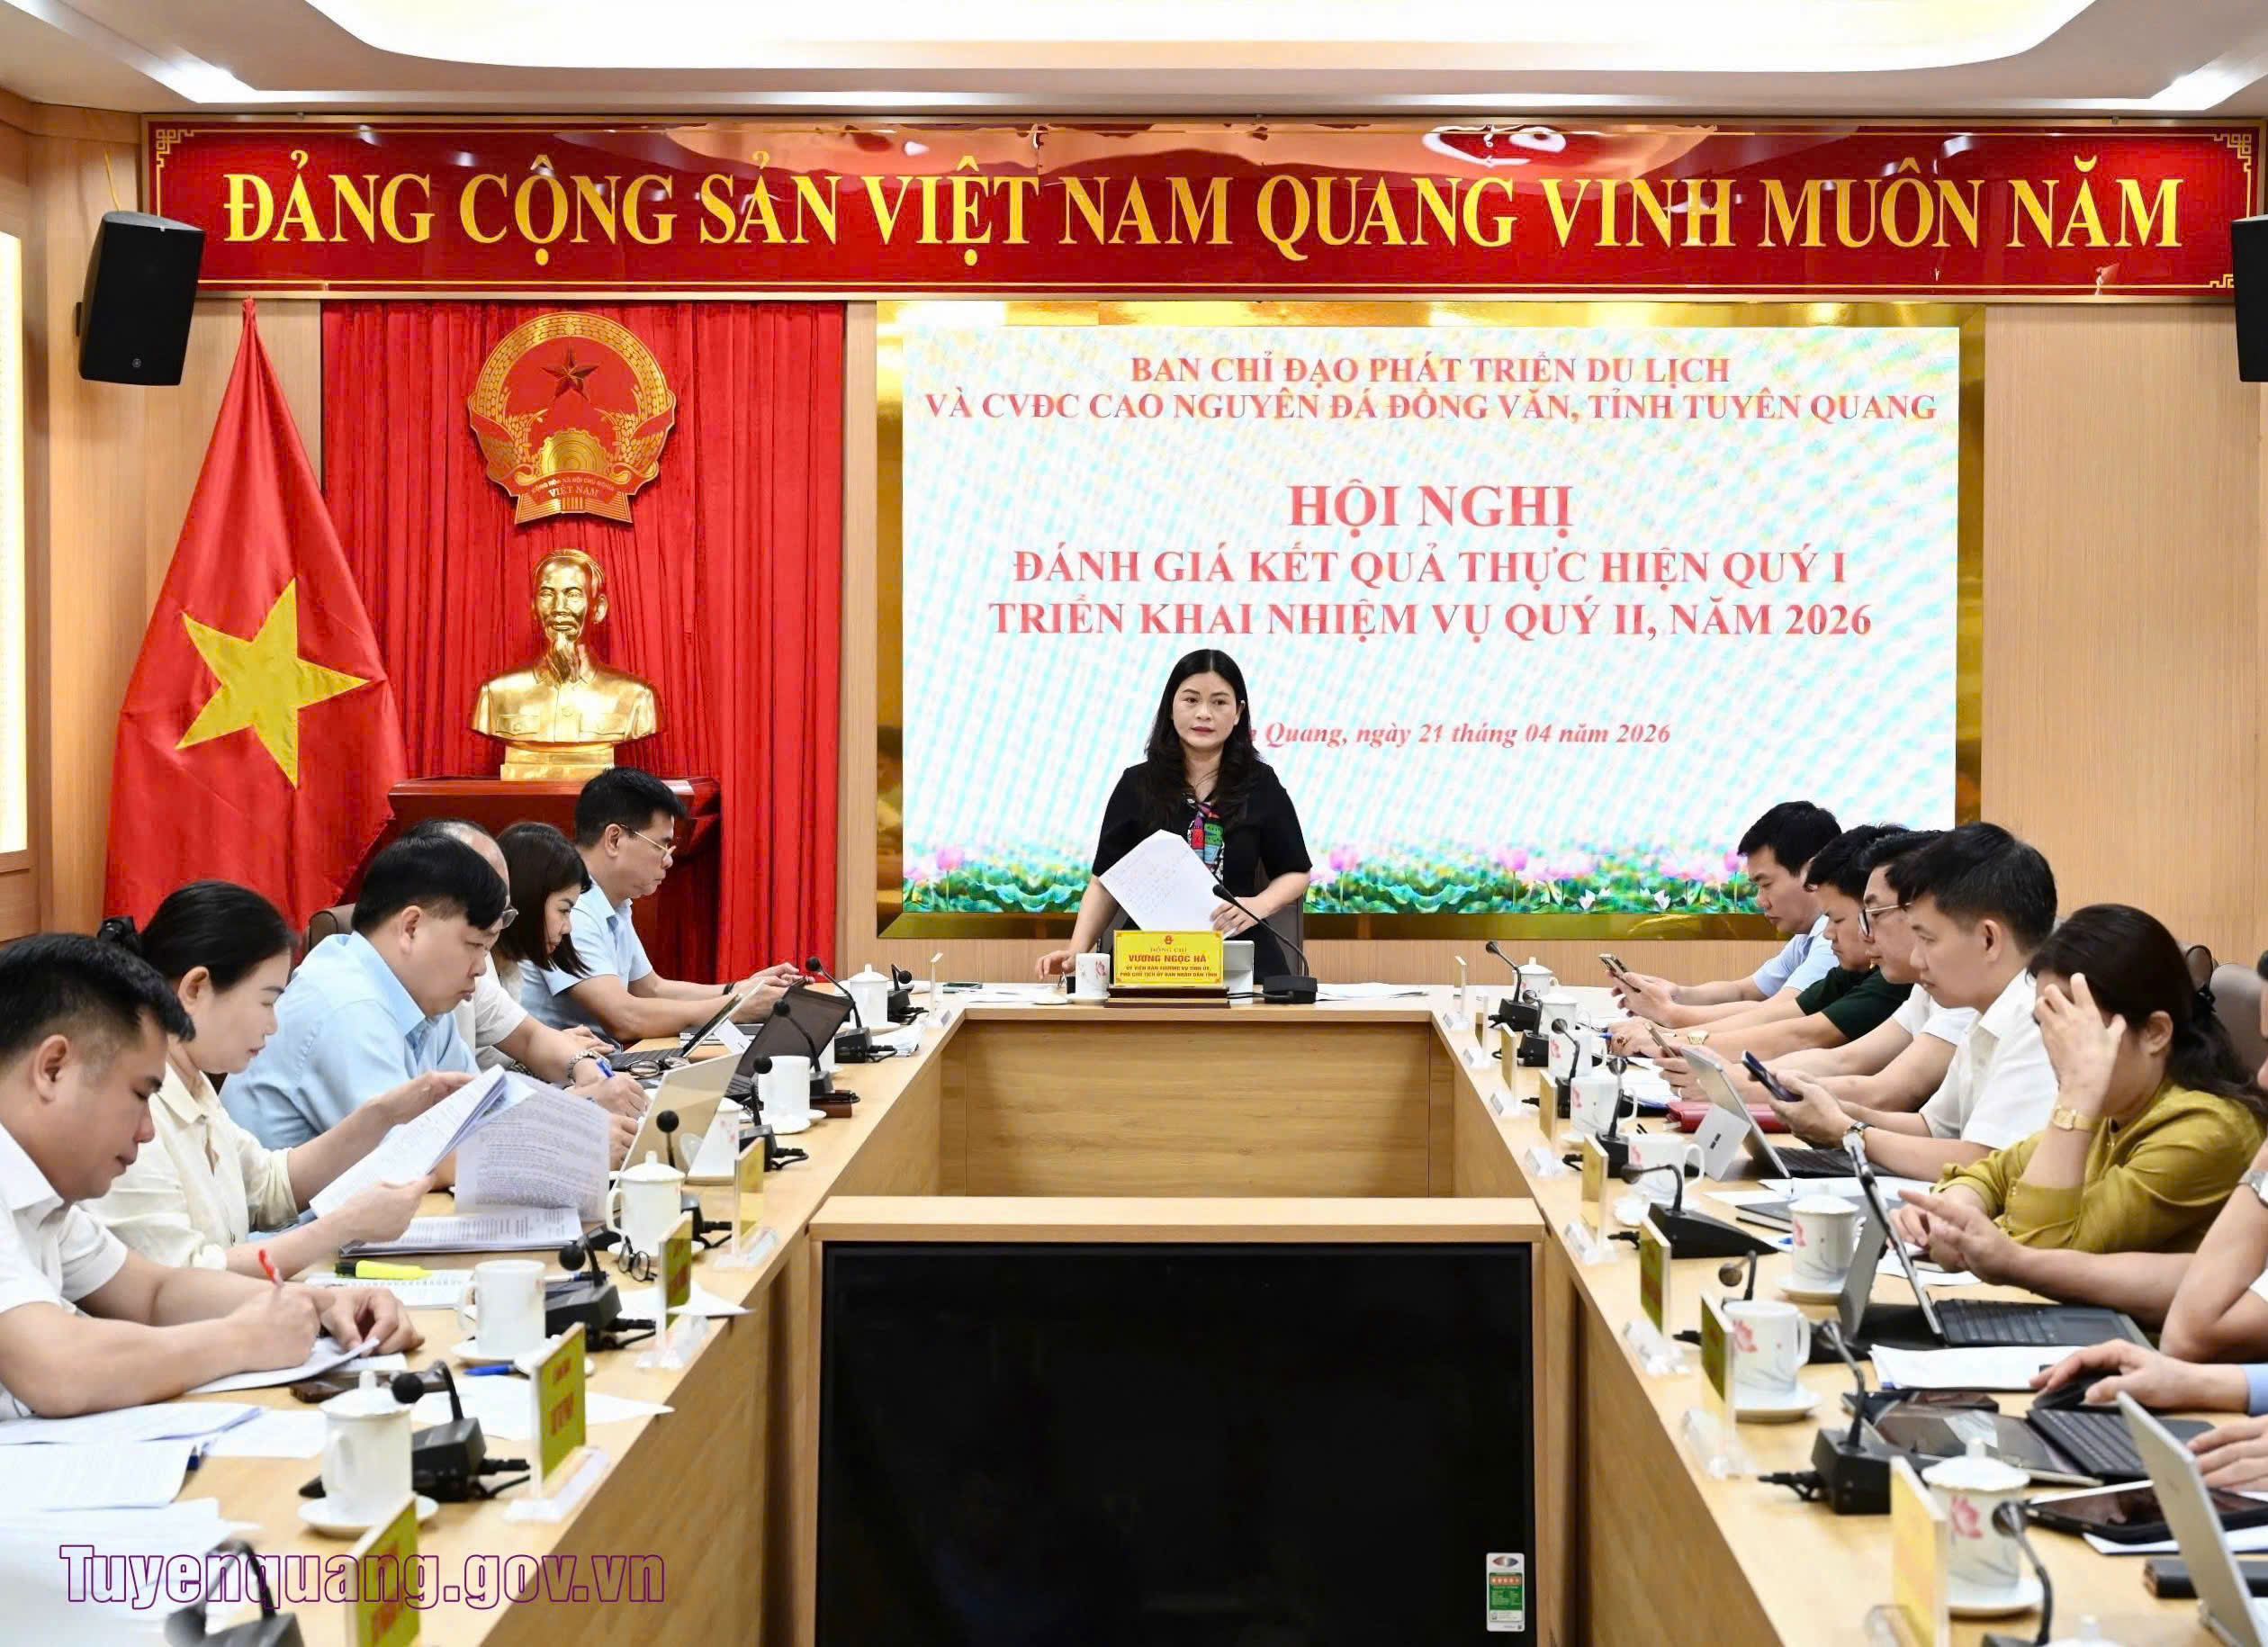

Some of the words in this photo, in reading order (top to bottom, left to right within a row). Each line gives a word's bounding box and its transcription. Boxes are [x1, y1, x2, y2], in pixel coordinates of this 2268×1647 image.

[223, 149, 436, 243] ĐẢNG
[459, 153, 679, 266] CỘNG
[700, 149, 842, 245] SẢN
[860, 155, 1040, 266] VIỆT
[1058, 176, 1233, 246] NAM
[1256, 174, 1517, 262] QUANG
[1538, 176, 1737, 248] VINH
[1758, 156, 1982, 248] MUÔN
[2006, 154, 2185, 248] NĂM
[1130, 357, 1202, 382] BAN
[1210, 349, 1273, 382] CHỈ
[1284, 357, 1359, 389] ĐẠO
[1370, 349, 1462, 382] PHÁT
[1470, 349, 1576, 382] TRIỂN
[1587, 358, 1634, 382] DU
[1645, 358, 1730, 389] LỊCH
[924, 386, 972, 418] VÀ
[981, 394, 1080, 418] CVĐC
[1088, 394, 1164, 418] CAO
[1173, 386, 1319, 419] NGUYÊN
[1328, 386, 1377, 418] ĐÁ
[1388, 384, 1488, 419] ĐỒNG
[1498, 387, 1580, 423] VĂN,
[1588, 386, 1672, 419] TỈNH
[1682, 386, 1800, 419] TUYÊN
[1809, 394, 1937, 424] QUANG
[575, 485, 599, 498] NAM
[1288, 478, 1400, 538] HỘI
[1417, 484, 1574, 538] NGHỊ
[1012, 544, 1140, 582] ĐÁNH
[1152, 544, 1234, 582] GIÁ
[1248, 541, 1338, 582] KẾT
[1350, 542, 1445, 590] QUẢ
[1458, 545, 1588, 591] THỰC
[1600, 545, 1708, 591] HIỆN
[1722, 544, 1818, 590] QUÝ
[1832, 552, 1847, 582] I
[987, 594, 1125, 635] TRIỂN
[1138, 604, 1252, 635] KHAI
[1266, 598, 1416, 642] NHIỆM
[1431, 604, 1492, 643] VỤ
[1504, 596, 1601, 642] QUÝ
[1612, 604, 1656, 642] II,
[1669, 597, 1773, 635] NĂM
[1785, 604, 1872, 635] 2026
[1264, 722, 1348, 749] Quang,
[1354, 722, 1411, 749] ngày
[1418, 724, 1444, 743] 21
[1451, 722, 1518, 749] tháng
[1524, 724, 1552, 743] 04
[1558, 724, 1610, 743] năm
[1616, 724, 1672, 743] 2026
[1129, 954, 1162, 963] VƯƠNG
[1164, 954, 1191, 965] NGỌC
